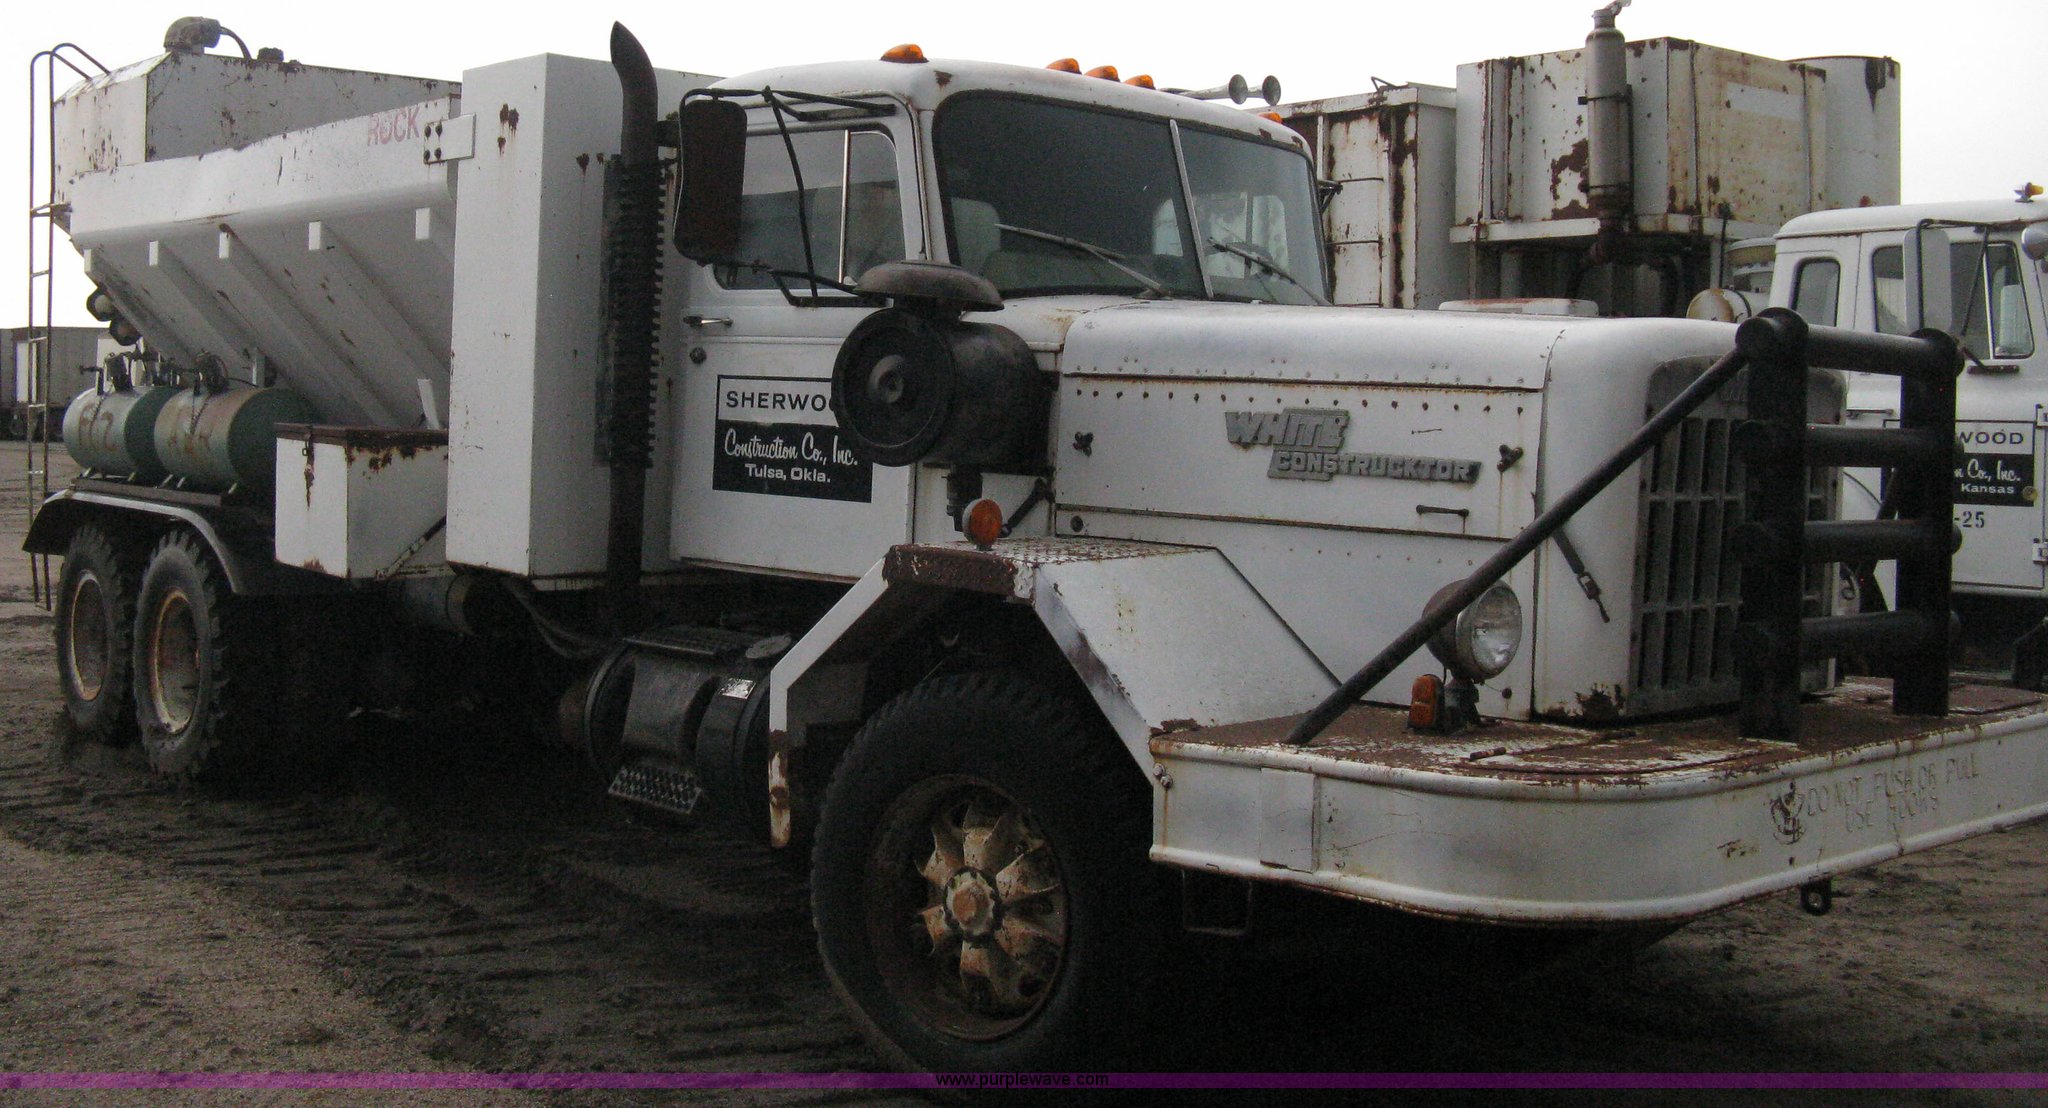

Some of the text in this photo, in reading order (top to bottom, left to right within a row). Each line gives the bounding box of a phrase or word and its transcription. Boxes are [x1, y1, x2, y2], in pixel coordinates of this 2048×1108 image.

[367, 106, 420, 147] ROCK
[725, 390, 836, 413] SHERWO
[1225, 410, 1349, 450] WHITE
[723, 428, 859, 466] Construction Co., Inc.
[745, 463, 831, 483] Tulsa, Okla.
[1274, 451, 1472, 482] CONSTRUCKTOR
[1996, 460, 2021, 482] Inc.
[1960, 483, 2015, 494] Kansas
